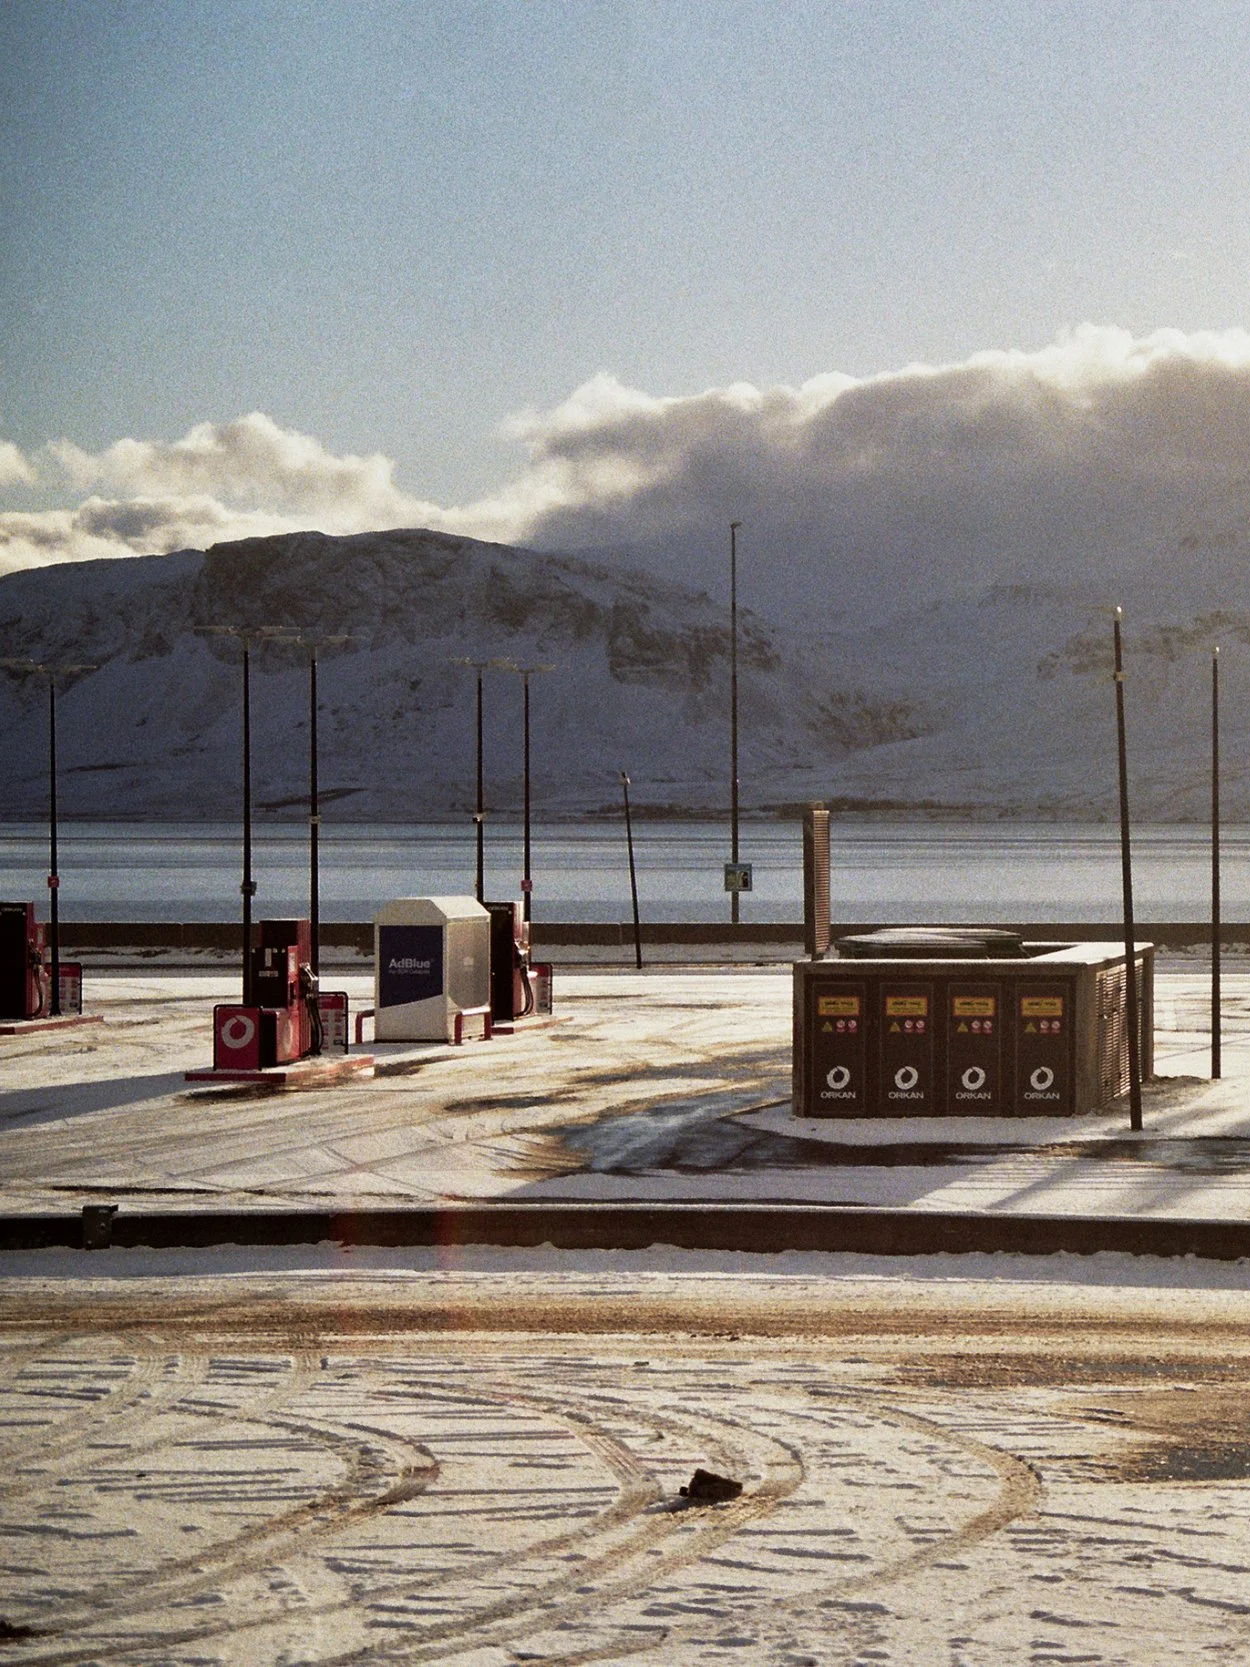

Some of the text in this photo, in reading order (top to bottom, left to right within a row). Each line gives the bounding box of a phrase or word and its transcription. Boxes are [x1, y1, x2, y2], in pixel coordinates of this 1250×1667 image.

[389, 958, 431, 968] AdBlue
[820, 1091, 856, 1099] ORKAN
[888, 1091, 924, 1099] ORKAN
[955, 1091, 992, 1100] ORKAN
[1024, 1091, 1060, 1100] ORKAN
